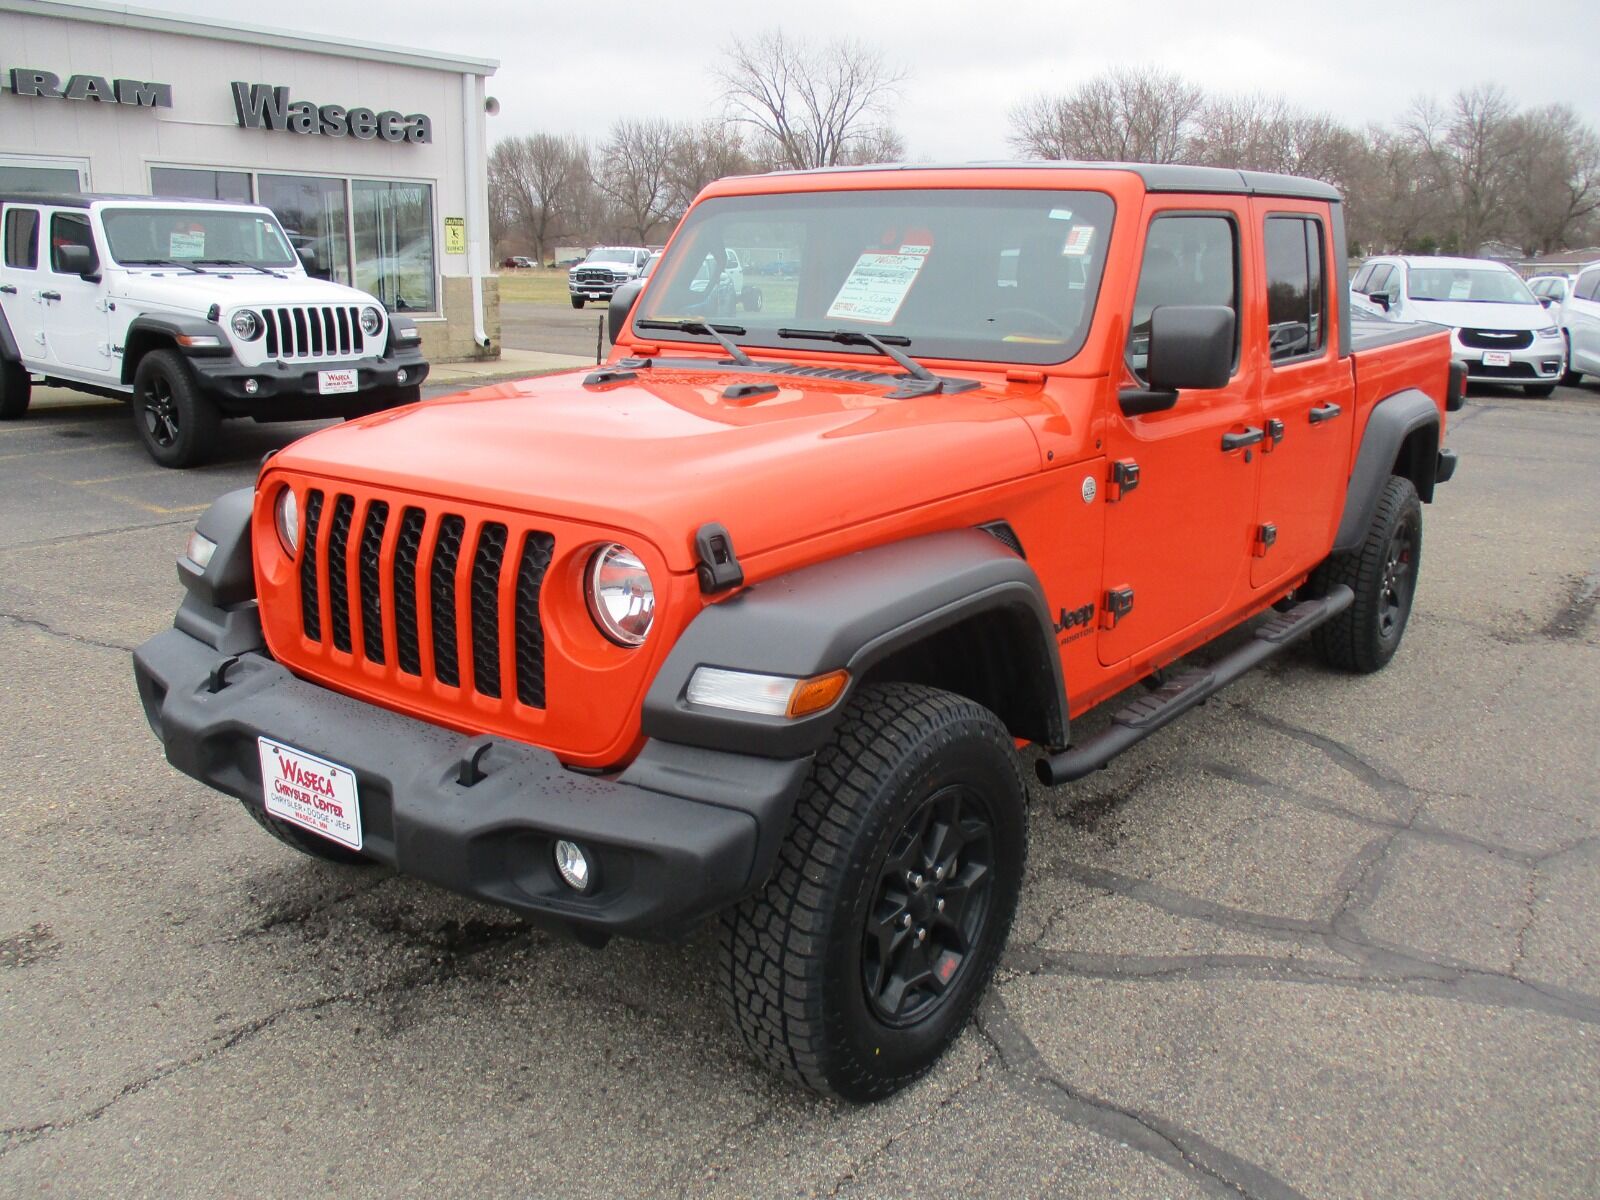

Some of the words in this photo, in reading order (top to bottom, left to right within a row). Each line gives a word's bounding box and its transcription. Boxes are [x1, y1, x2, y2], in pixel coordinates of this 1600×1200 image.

[10, 68, 173, 108] RAM
[231, 81, 433, 144] Waseca
[1054, 603, 1094, 634] Jeep
[279, 755, 335, 797] WASECA
[271, 793, 303, 811] CHRYSLER
[307, 807, 330, 823] DODGE
[334, 821, 351, 831] JEEP
[275, 779, 311, 805] CHRYSLER
[313, 795, 344, 818] CENTER
